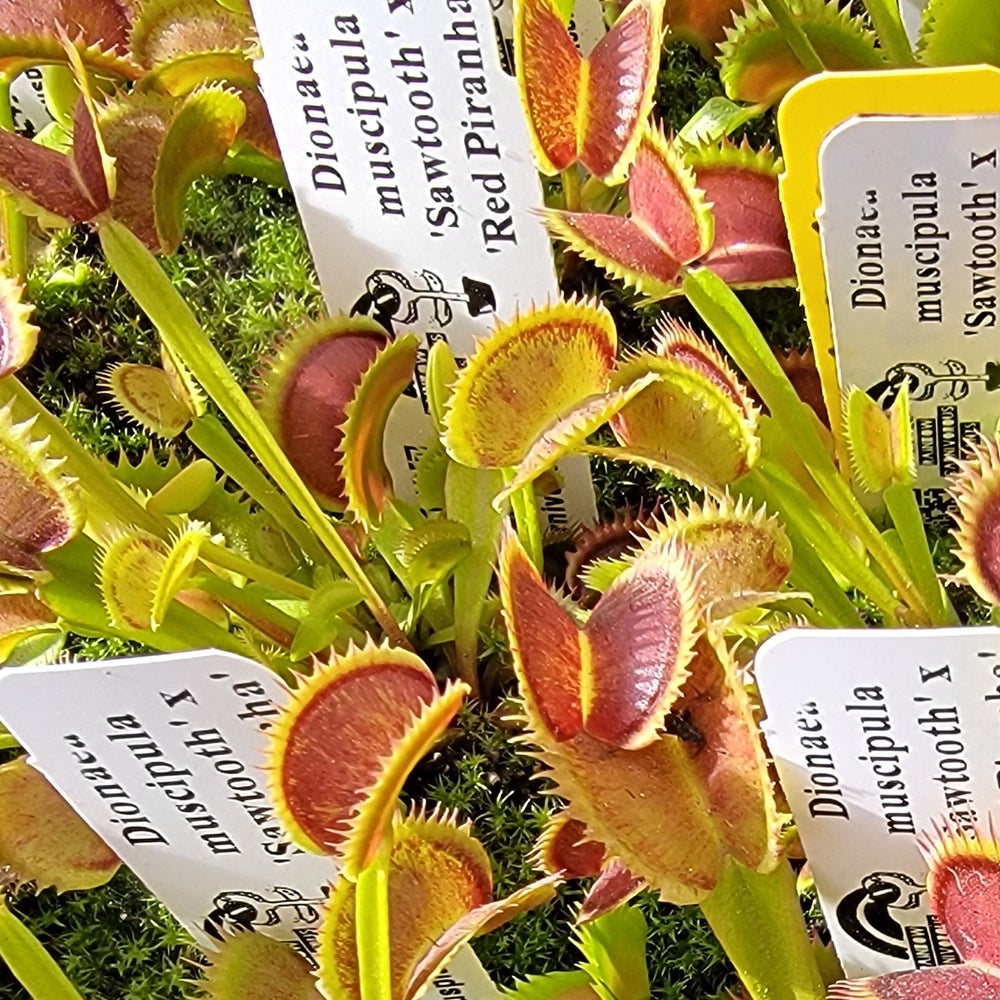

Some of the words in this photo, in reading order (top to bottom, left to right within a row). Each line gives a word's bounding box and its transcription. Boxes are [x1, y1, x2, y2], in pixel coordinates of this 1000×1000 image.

[329, 14, 405, 218] muscipula
[384, 31, 459, 238] 'Sawtooth'
[971, 149, 997, 169] x
[470, 172, 518, 254] 'Red
[902, 171, 949, 323] muscipula
[961, 182, 997, 336] 'Sawtooth'
[919, 665, 952, 684] x
[106, 713, 242, 855] muscipula
[845, 685, 916, 835] muscipula
